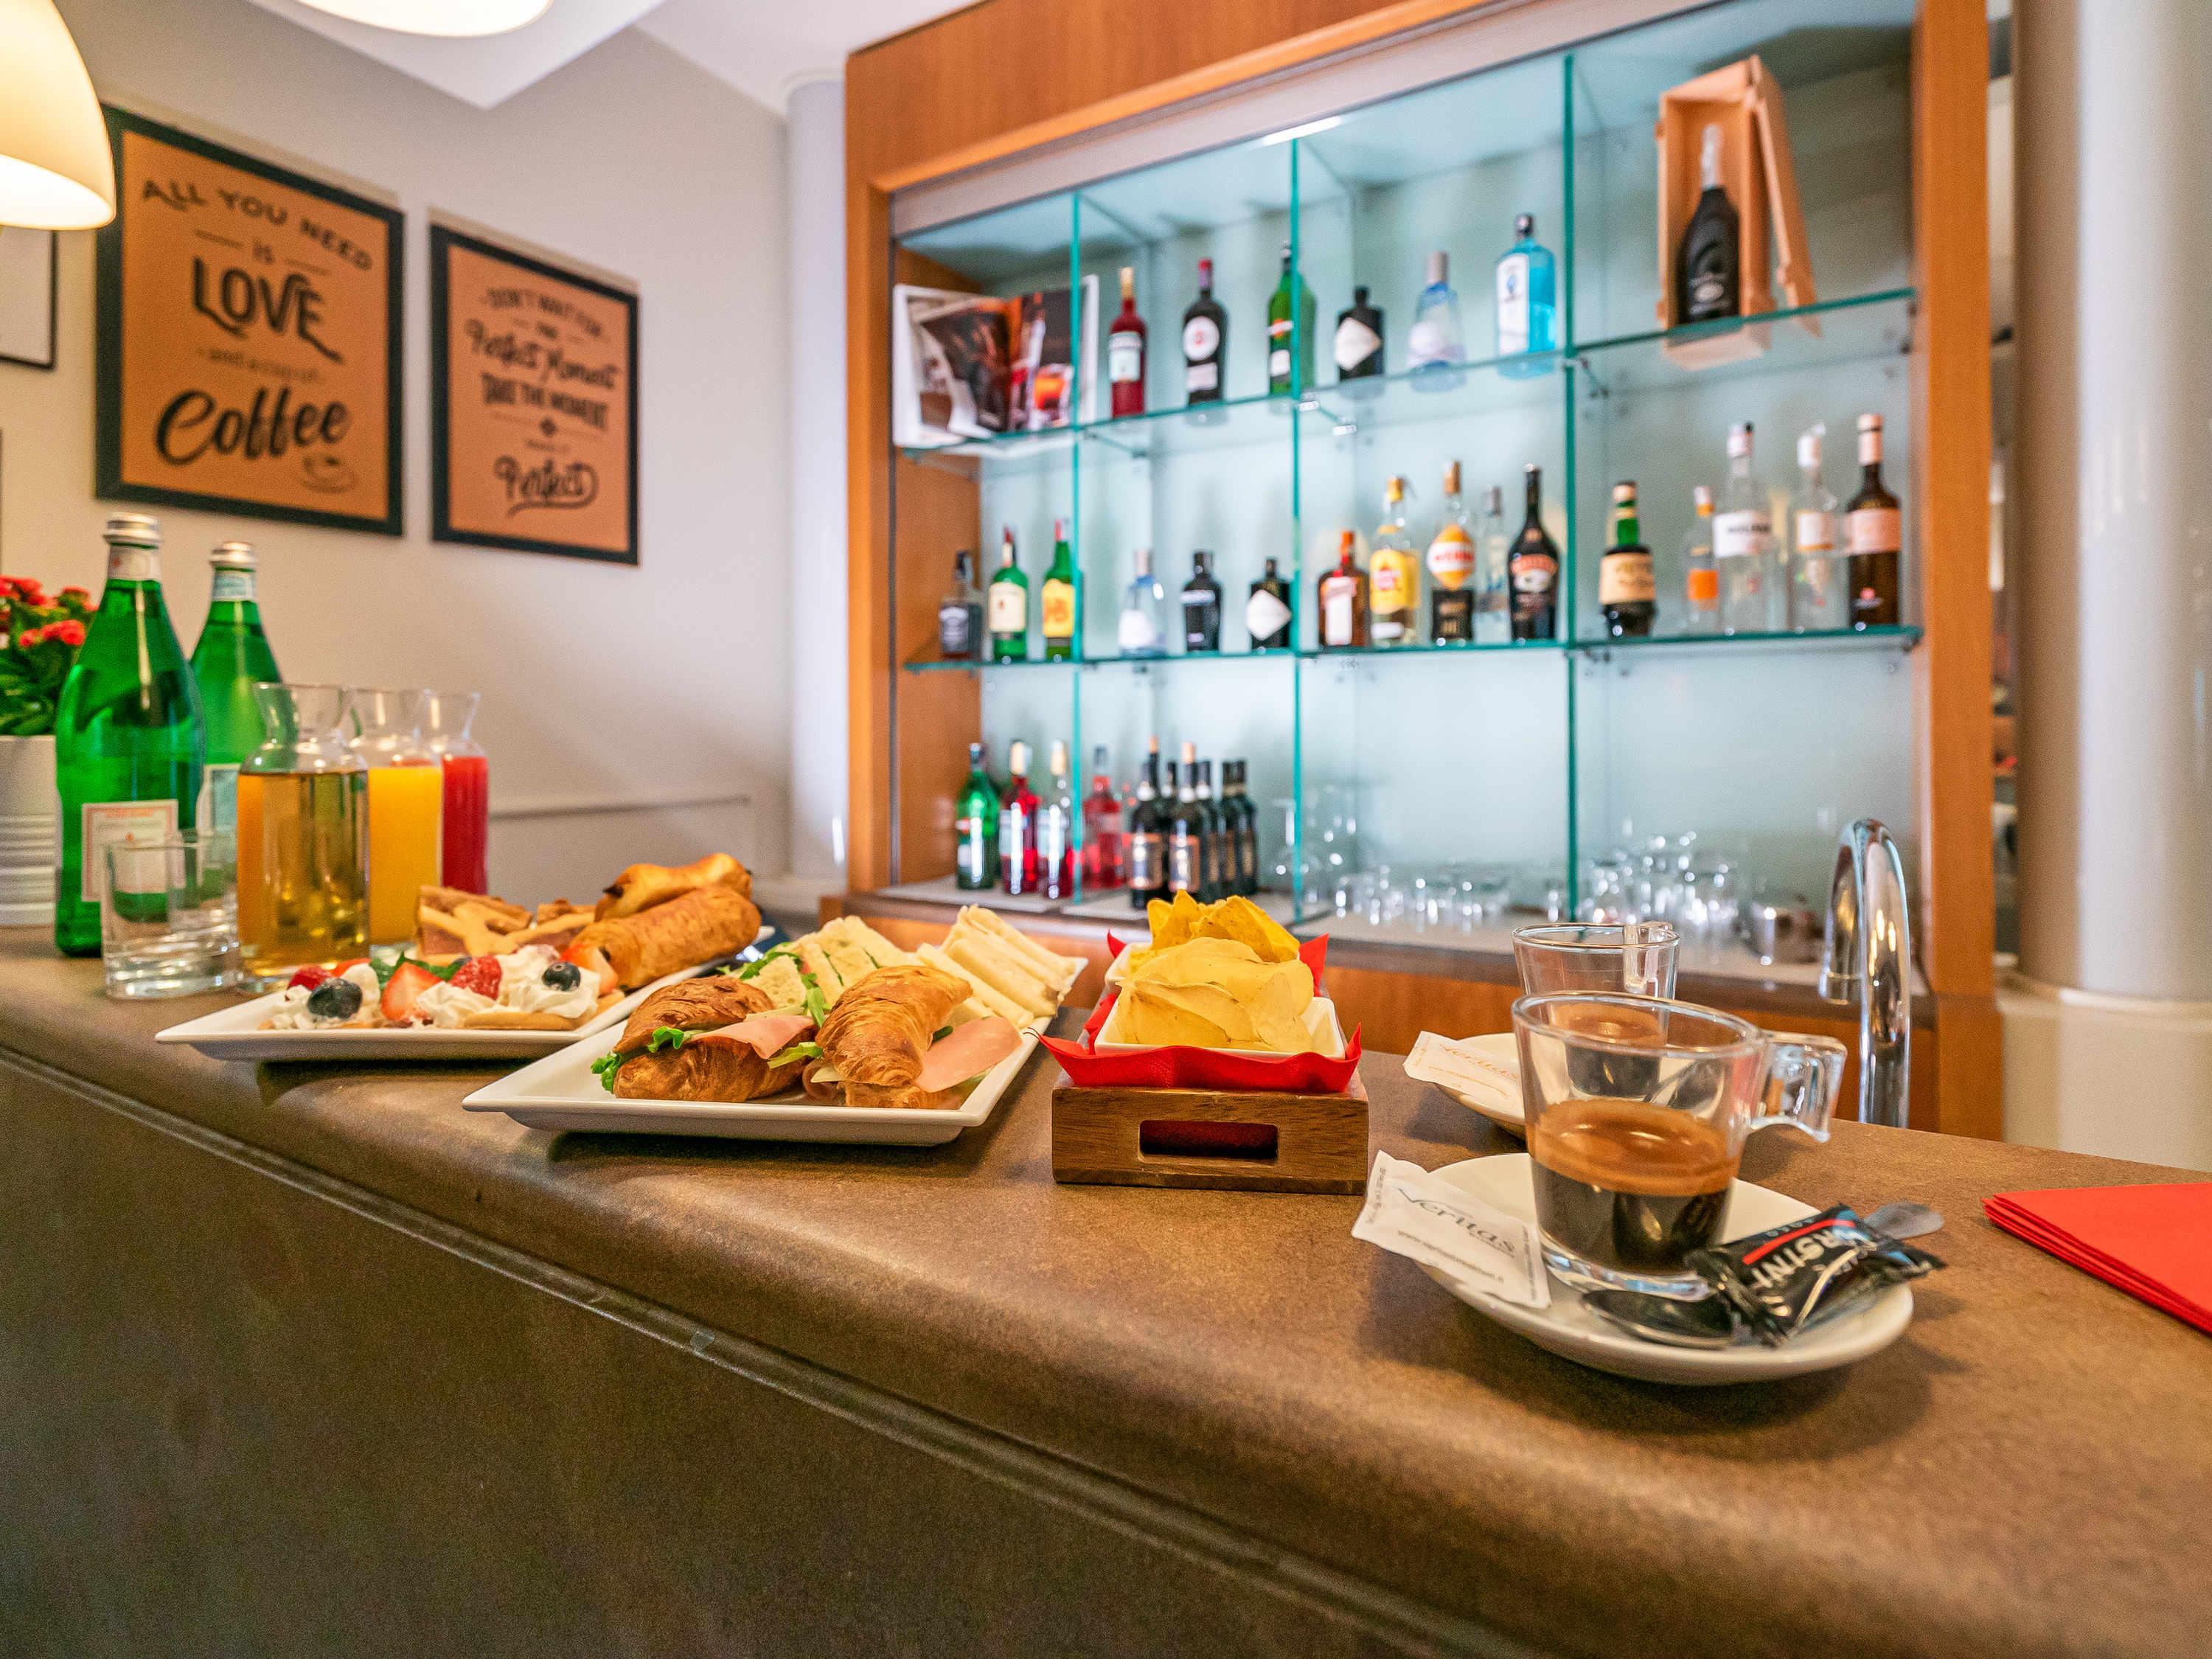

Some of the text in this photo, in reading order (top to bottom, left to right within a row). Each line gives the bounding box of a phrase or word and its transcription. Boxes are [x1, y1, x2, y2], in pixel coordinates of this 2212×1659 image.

[143, 180, 372, 271] ALL YOU NEED
[192, 254, 345, 364] LOVE
[156, 388, 353, 467] Coffee
